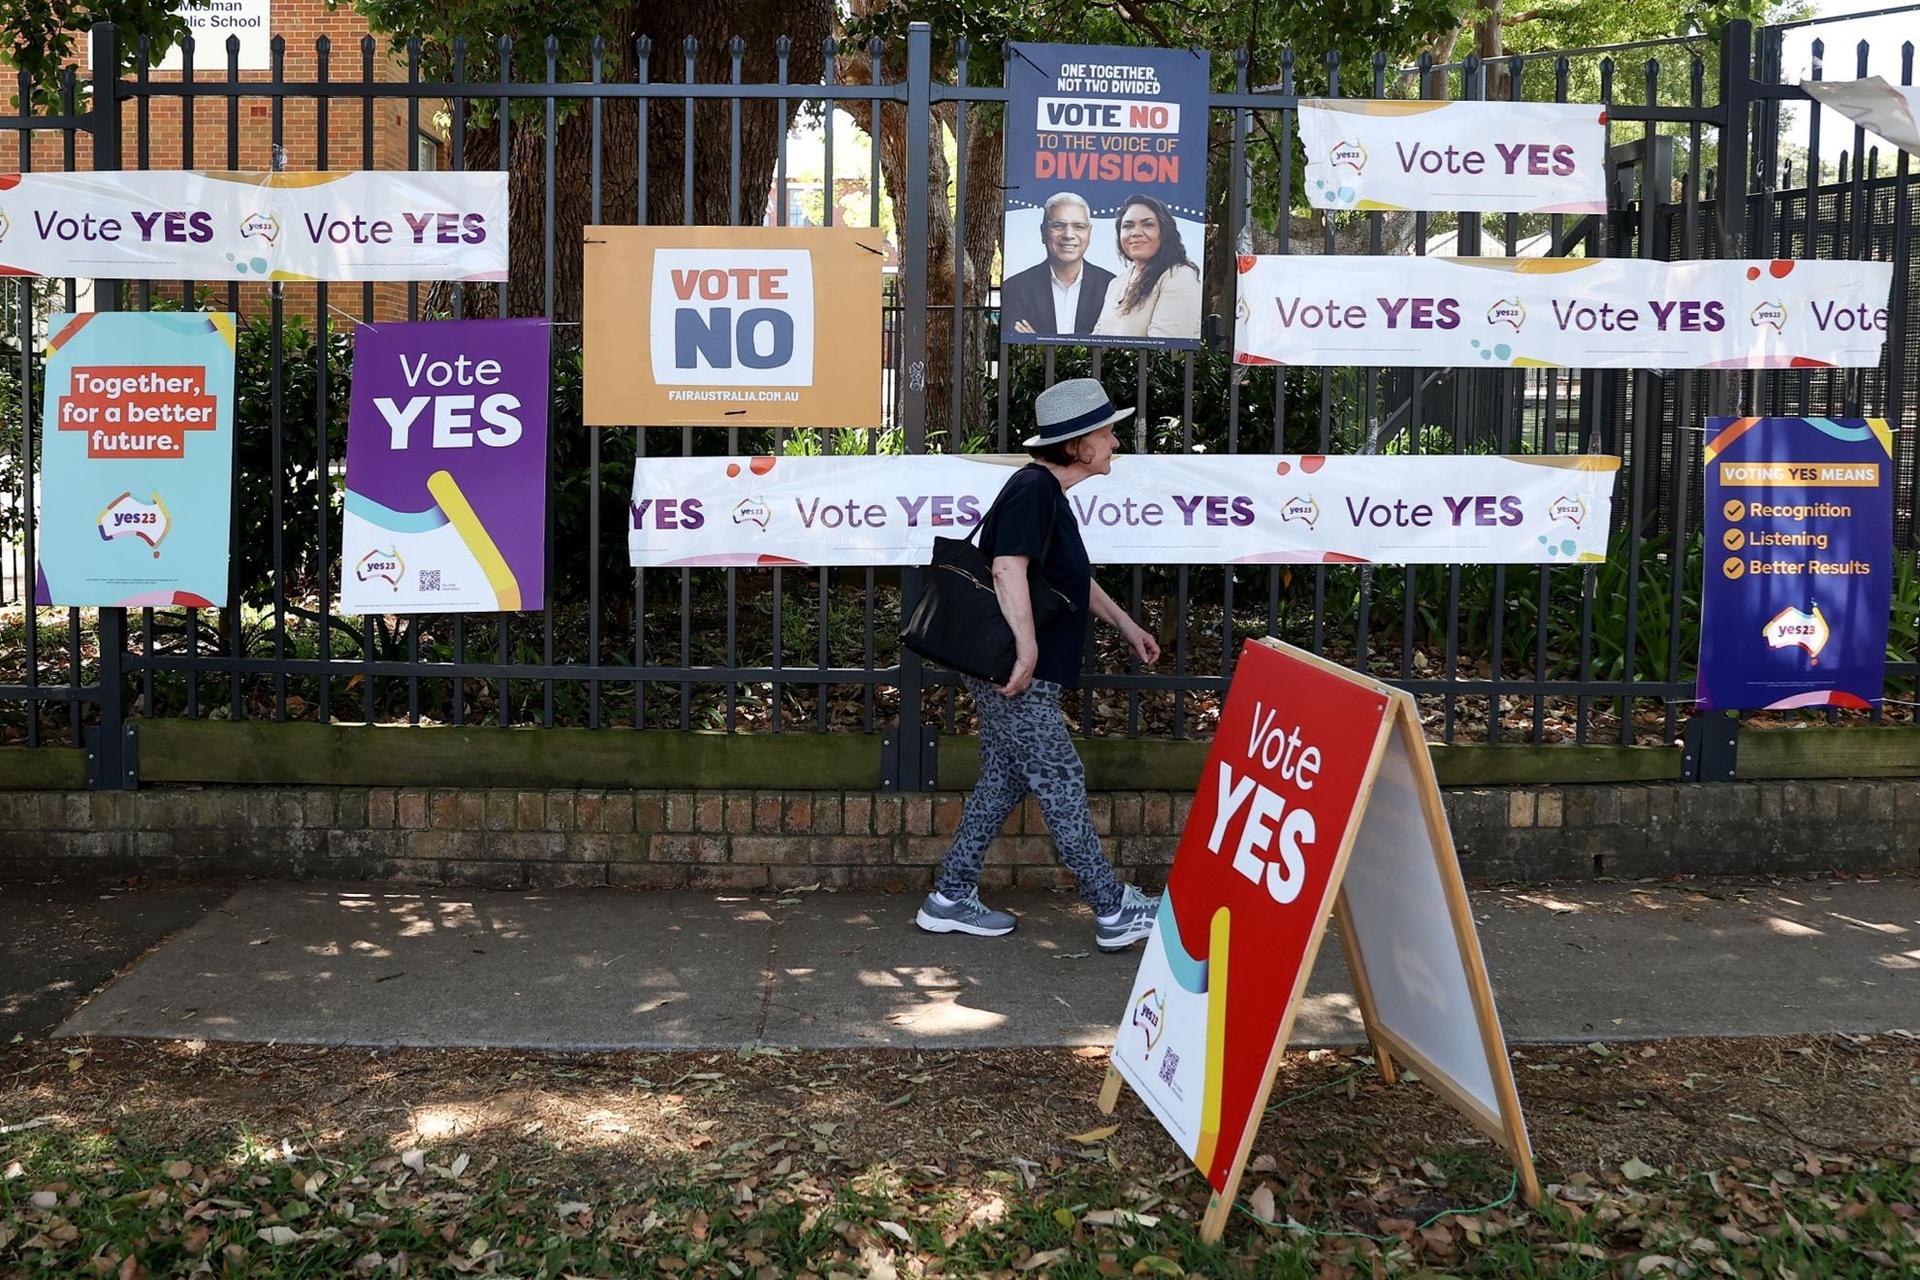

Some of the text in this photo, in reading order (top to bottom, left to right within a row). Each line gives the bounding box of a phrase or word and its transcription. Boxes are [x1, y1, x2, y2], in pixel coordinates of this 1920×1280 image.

[211, 15, 260, 27] School
[1057, 79, 1160, 94] NOT TWO DIVIDED
[1061, 64, 1157, 81] ONE TOGETHER,
[1047, 103, 1169, 129] VOTE NO
[1037, 134, 1179, 152] TO THE VOICE OF
[1035, 152, 1179, 183] DIVISION
[1396, 142, 1575, 176] Vote YES
[34, 211, 213, 243] Vote YES
[304, 213, 486, 244] Vote YES
[671, 269, 788, 300] VOTE
[1276, 297, 1460, 329] Vote YES
[1552, 300, 1725, 332] Vote YES
[1811, 303, 1888, 331] Vote
[675, 307, 794, 369] NO
[400, 353, 501, 387] Vote
[75, 373, 201, 398] Together,
[669, 391, 798, 401] FAIRAUSTRALIA.COM.AU
[63, 402, 212, 422] for a better
[373, 394, 522, 449] YES
[92, 430, 180, 451] future.
[1725, 468, 1874, 481] VOTING YES MEANS
[114, 513, 156, 526] yes23
[631, 498, 704, 530] YES
[796, 496, 979, 528] Vote YES
[1073, 495, 1255, 526] Vote YES
[1346, 496, 1523, 527] Vote YES
[1751, 503, 1850, 521] Recognition
[1750, 531, 1827, 549] Listening
[368, 563, 395, 572] yes23
[1750, 560, 1870, 575] Better Results
[1779, 625, 1815, 637] yes23
[1247, 701, 1321, 791] Vote
[1207, 762, 1316, 904] YES
